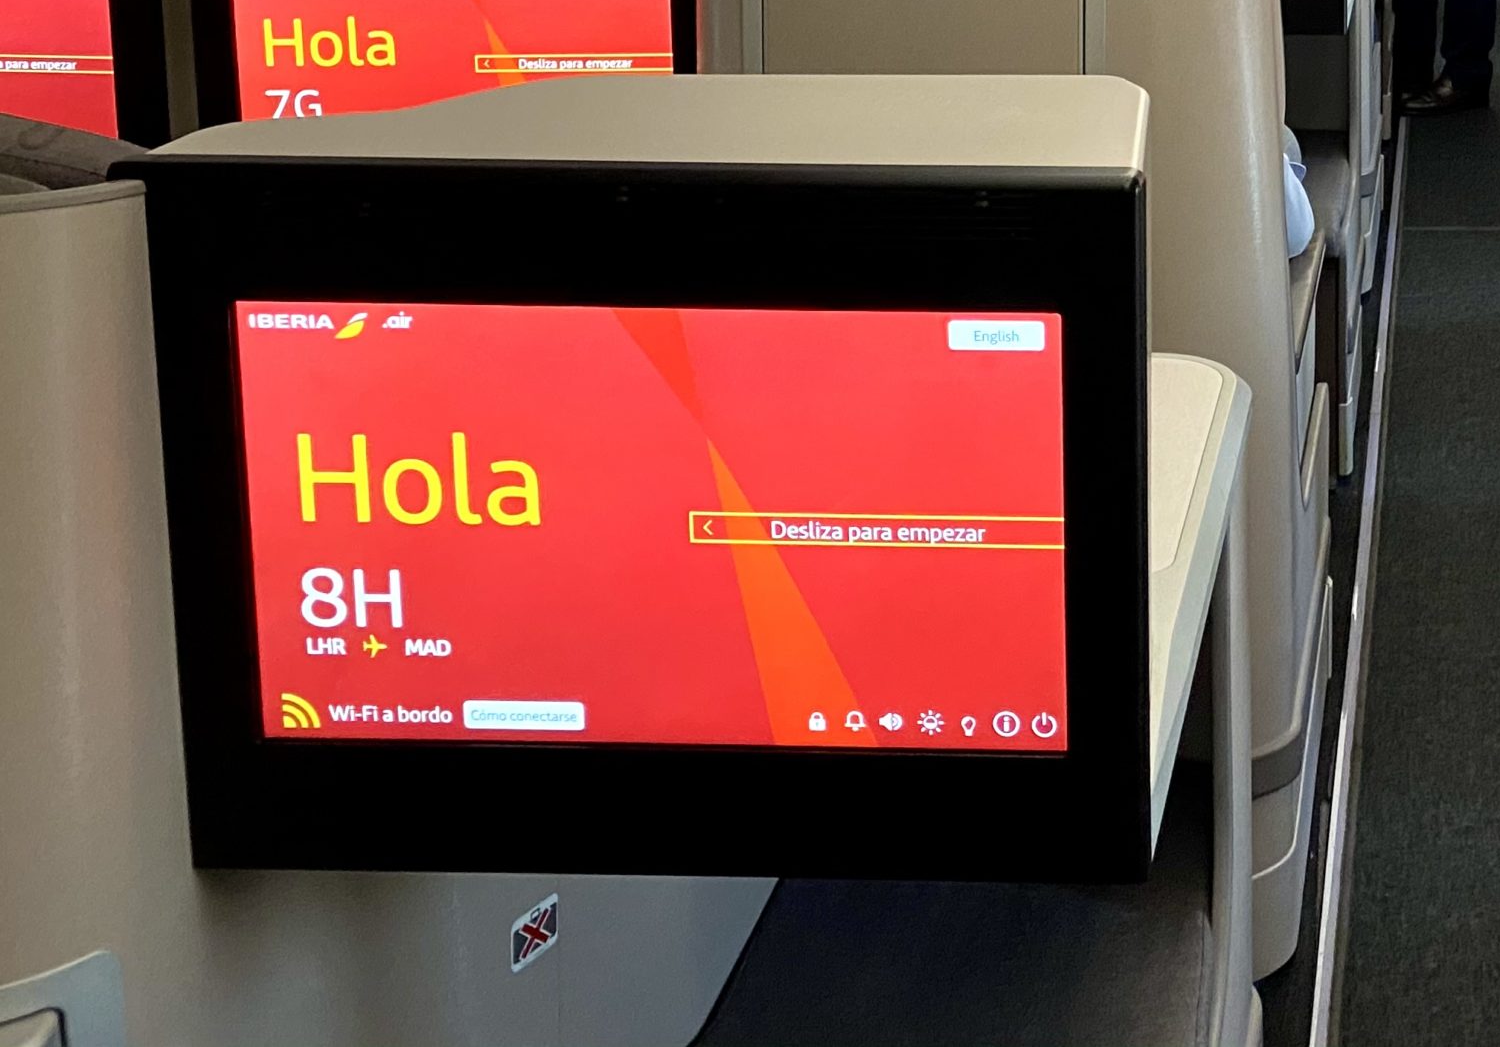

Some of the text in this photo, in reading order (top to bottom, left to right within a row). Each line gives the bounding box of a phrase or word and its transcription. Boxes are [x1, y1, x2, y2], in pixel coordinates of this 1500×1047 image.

[262, 15, 396, 67] Hola
[5, 61, 29, 72] para
[31, 61, 77, 72] empezar
[518, 58, 633, 70] Desliza para empezar
[264, 89, 323, 119] 7G
[248, 313, 334, 329] IBERIA
[973, 330, 1019, 345] English
[297, 432, 541, 526] Hola
[770, 520, 986, 544] Desliza para empezar
[301, 567, 403, 628] 8H
[306, 637, 452, 657] LHR MAD
[328, 704, 453, 724] Wi-Fi a bordo
[470, 709, 577, 724] Cómo conectarse
